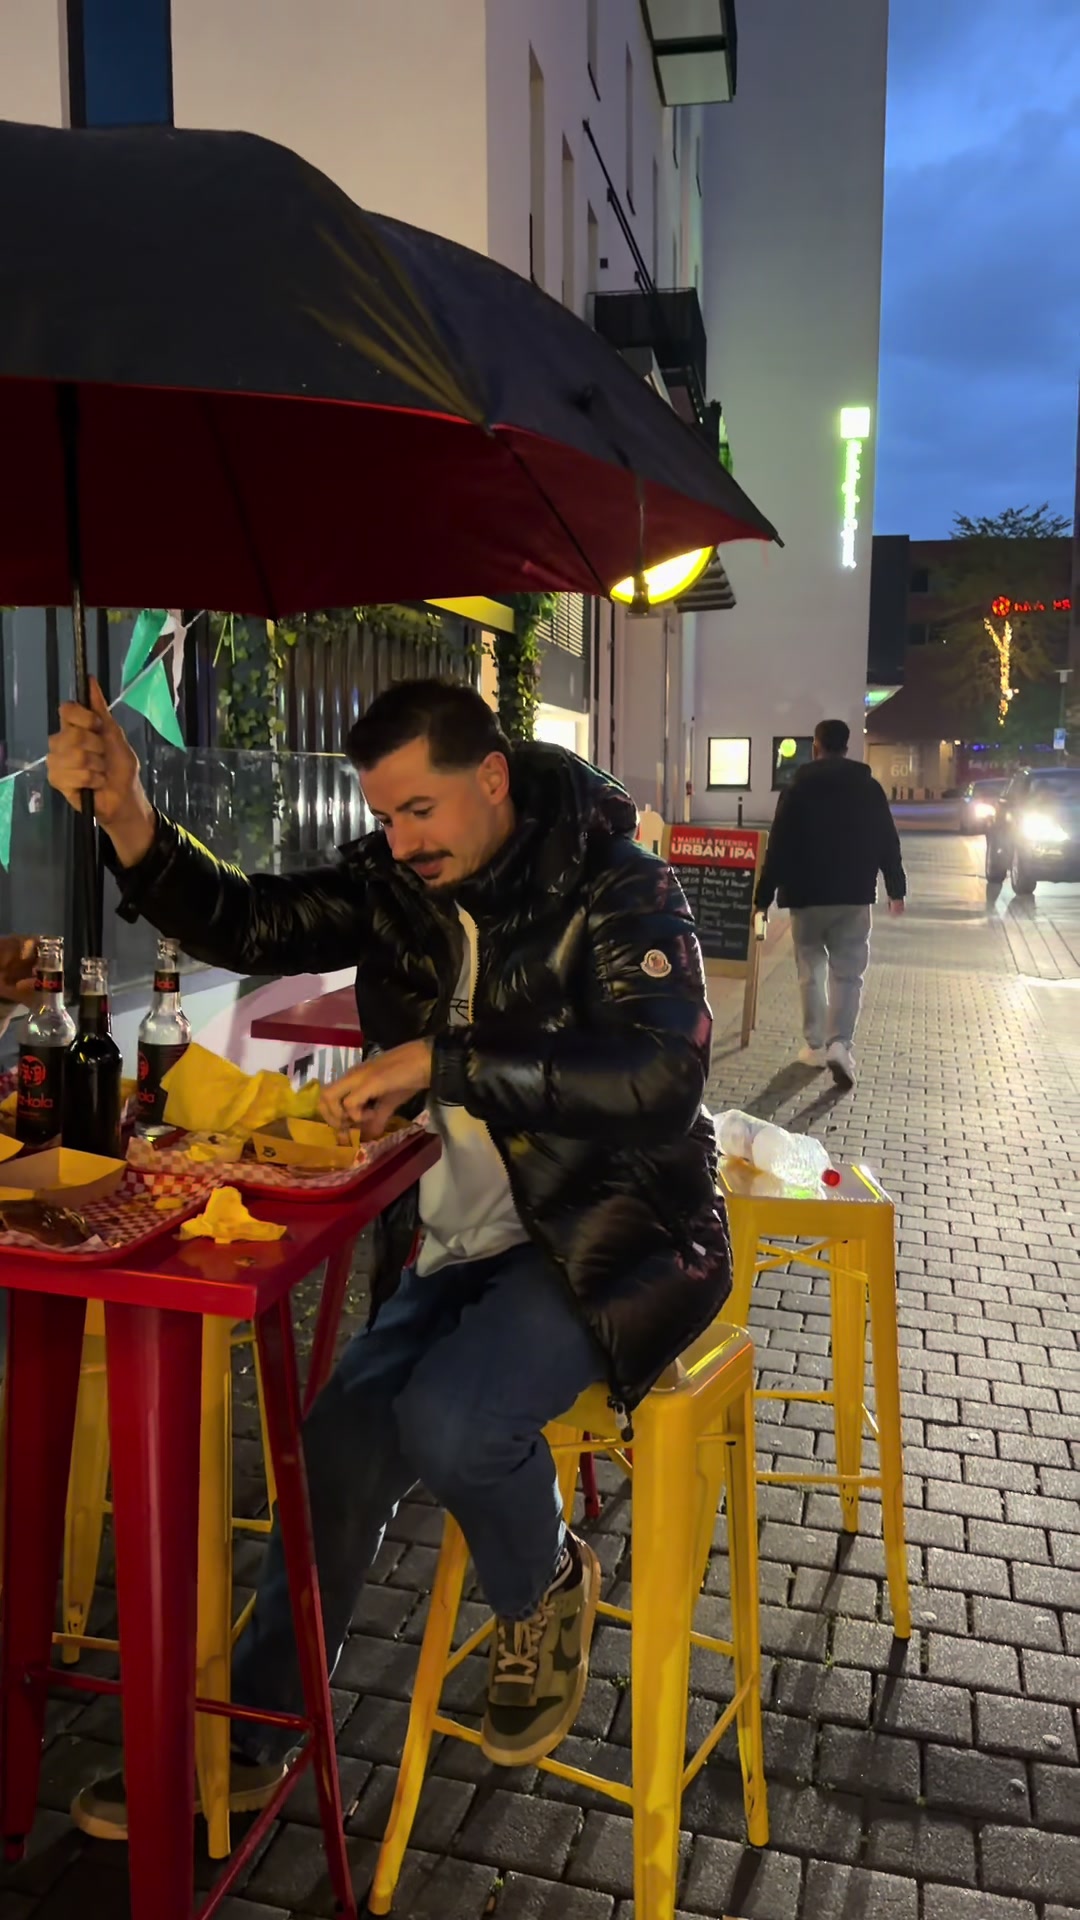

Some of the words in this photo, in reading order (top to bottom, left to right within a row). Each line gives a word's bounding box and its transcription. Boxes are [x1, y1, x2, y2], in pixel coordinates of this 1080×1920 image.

[714, 838, 748, 848] FRIENDS
[671, 842, 725, 857] URBAN
[729, 847, 755, 860] IPA
